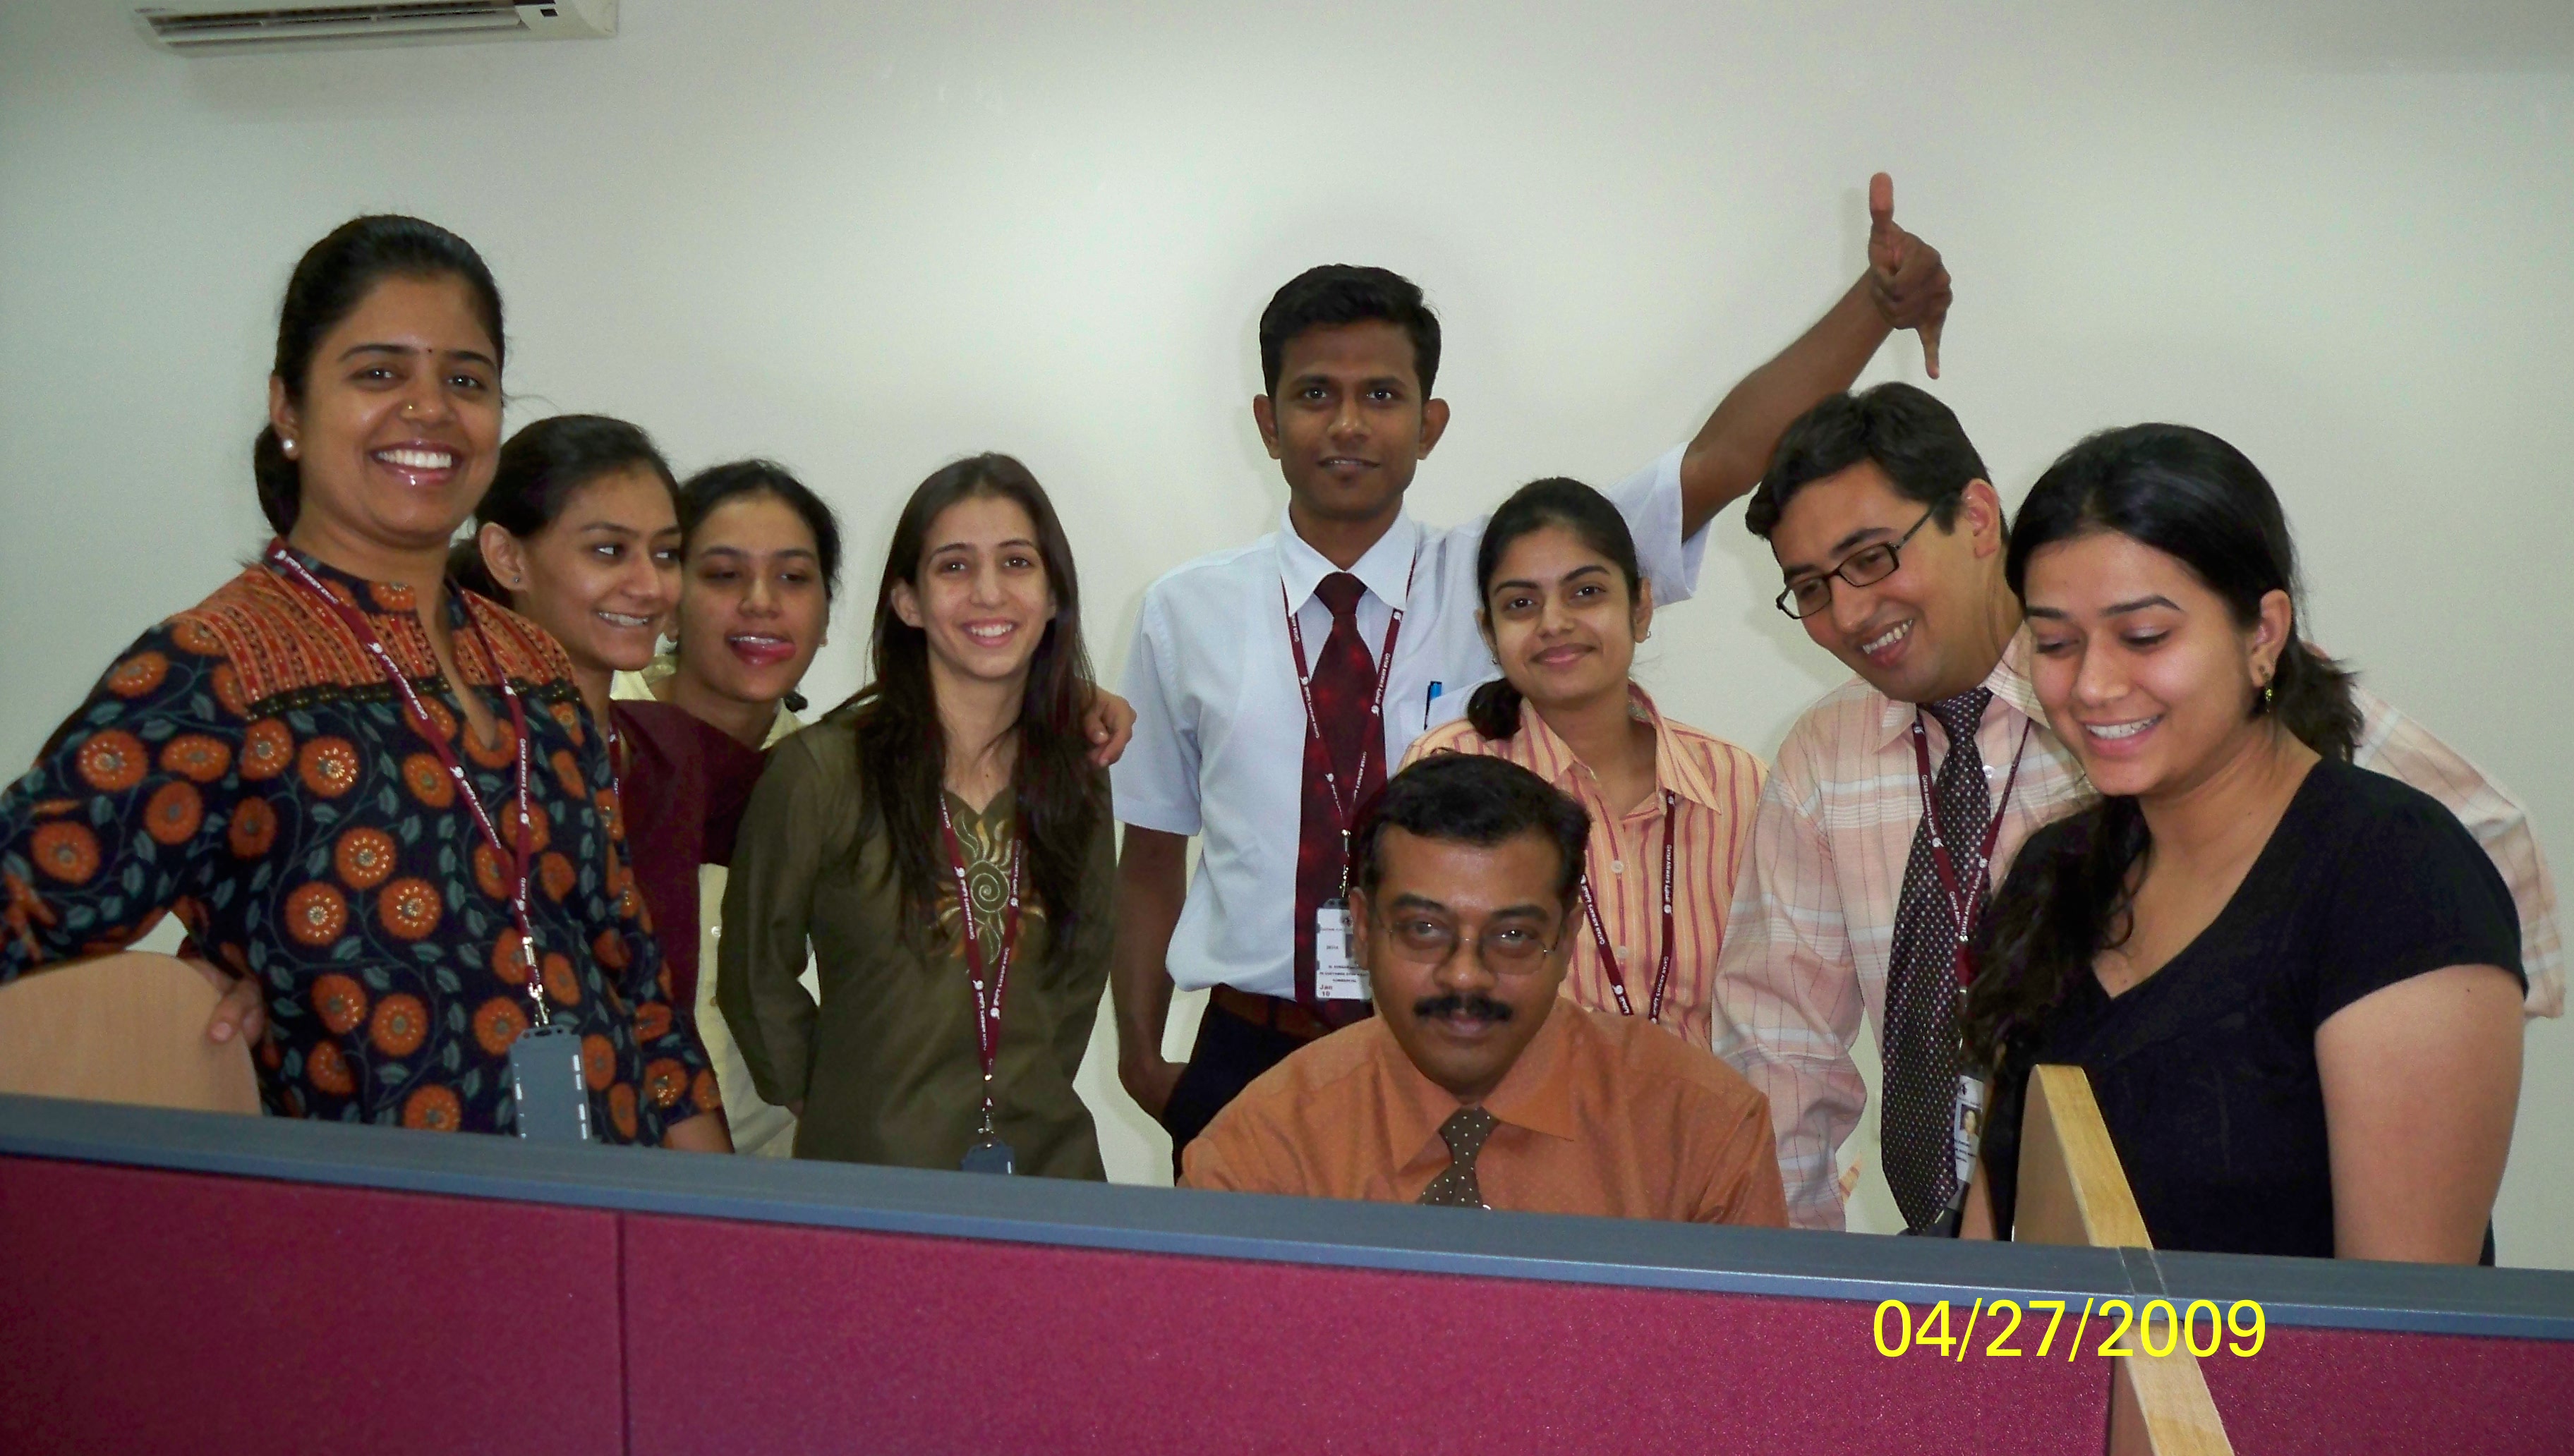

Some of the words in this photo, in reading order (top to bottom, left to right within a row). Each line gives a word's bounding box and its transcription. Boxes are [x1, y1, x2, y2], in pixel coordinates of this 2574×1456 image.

[1949, 891, 1958, 910] QATAR
[1964, 890, 1975, 915] AIRWAYS
[1588, 904, 1598, 926] AIRWAYS
[1595, 927, 1605, 945] QATAR
